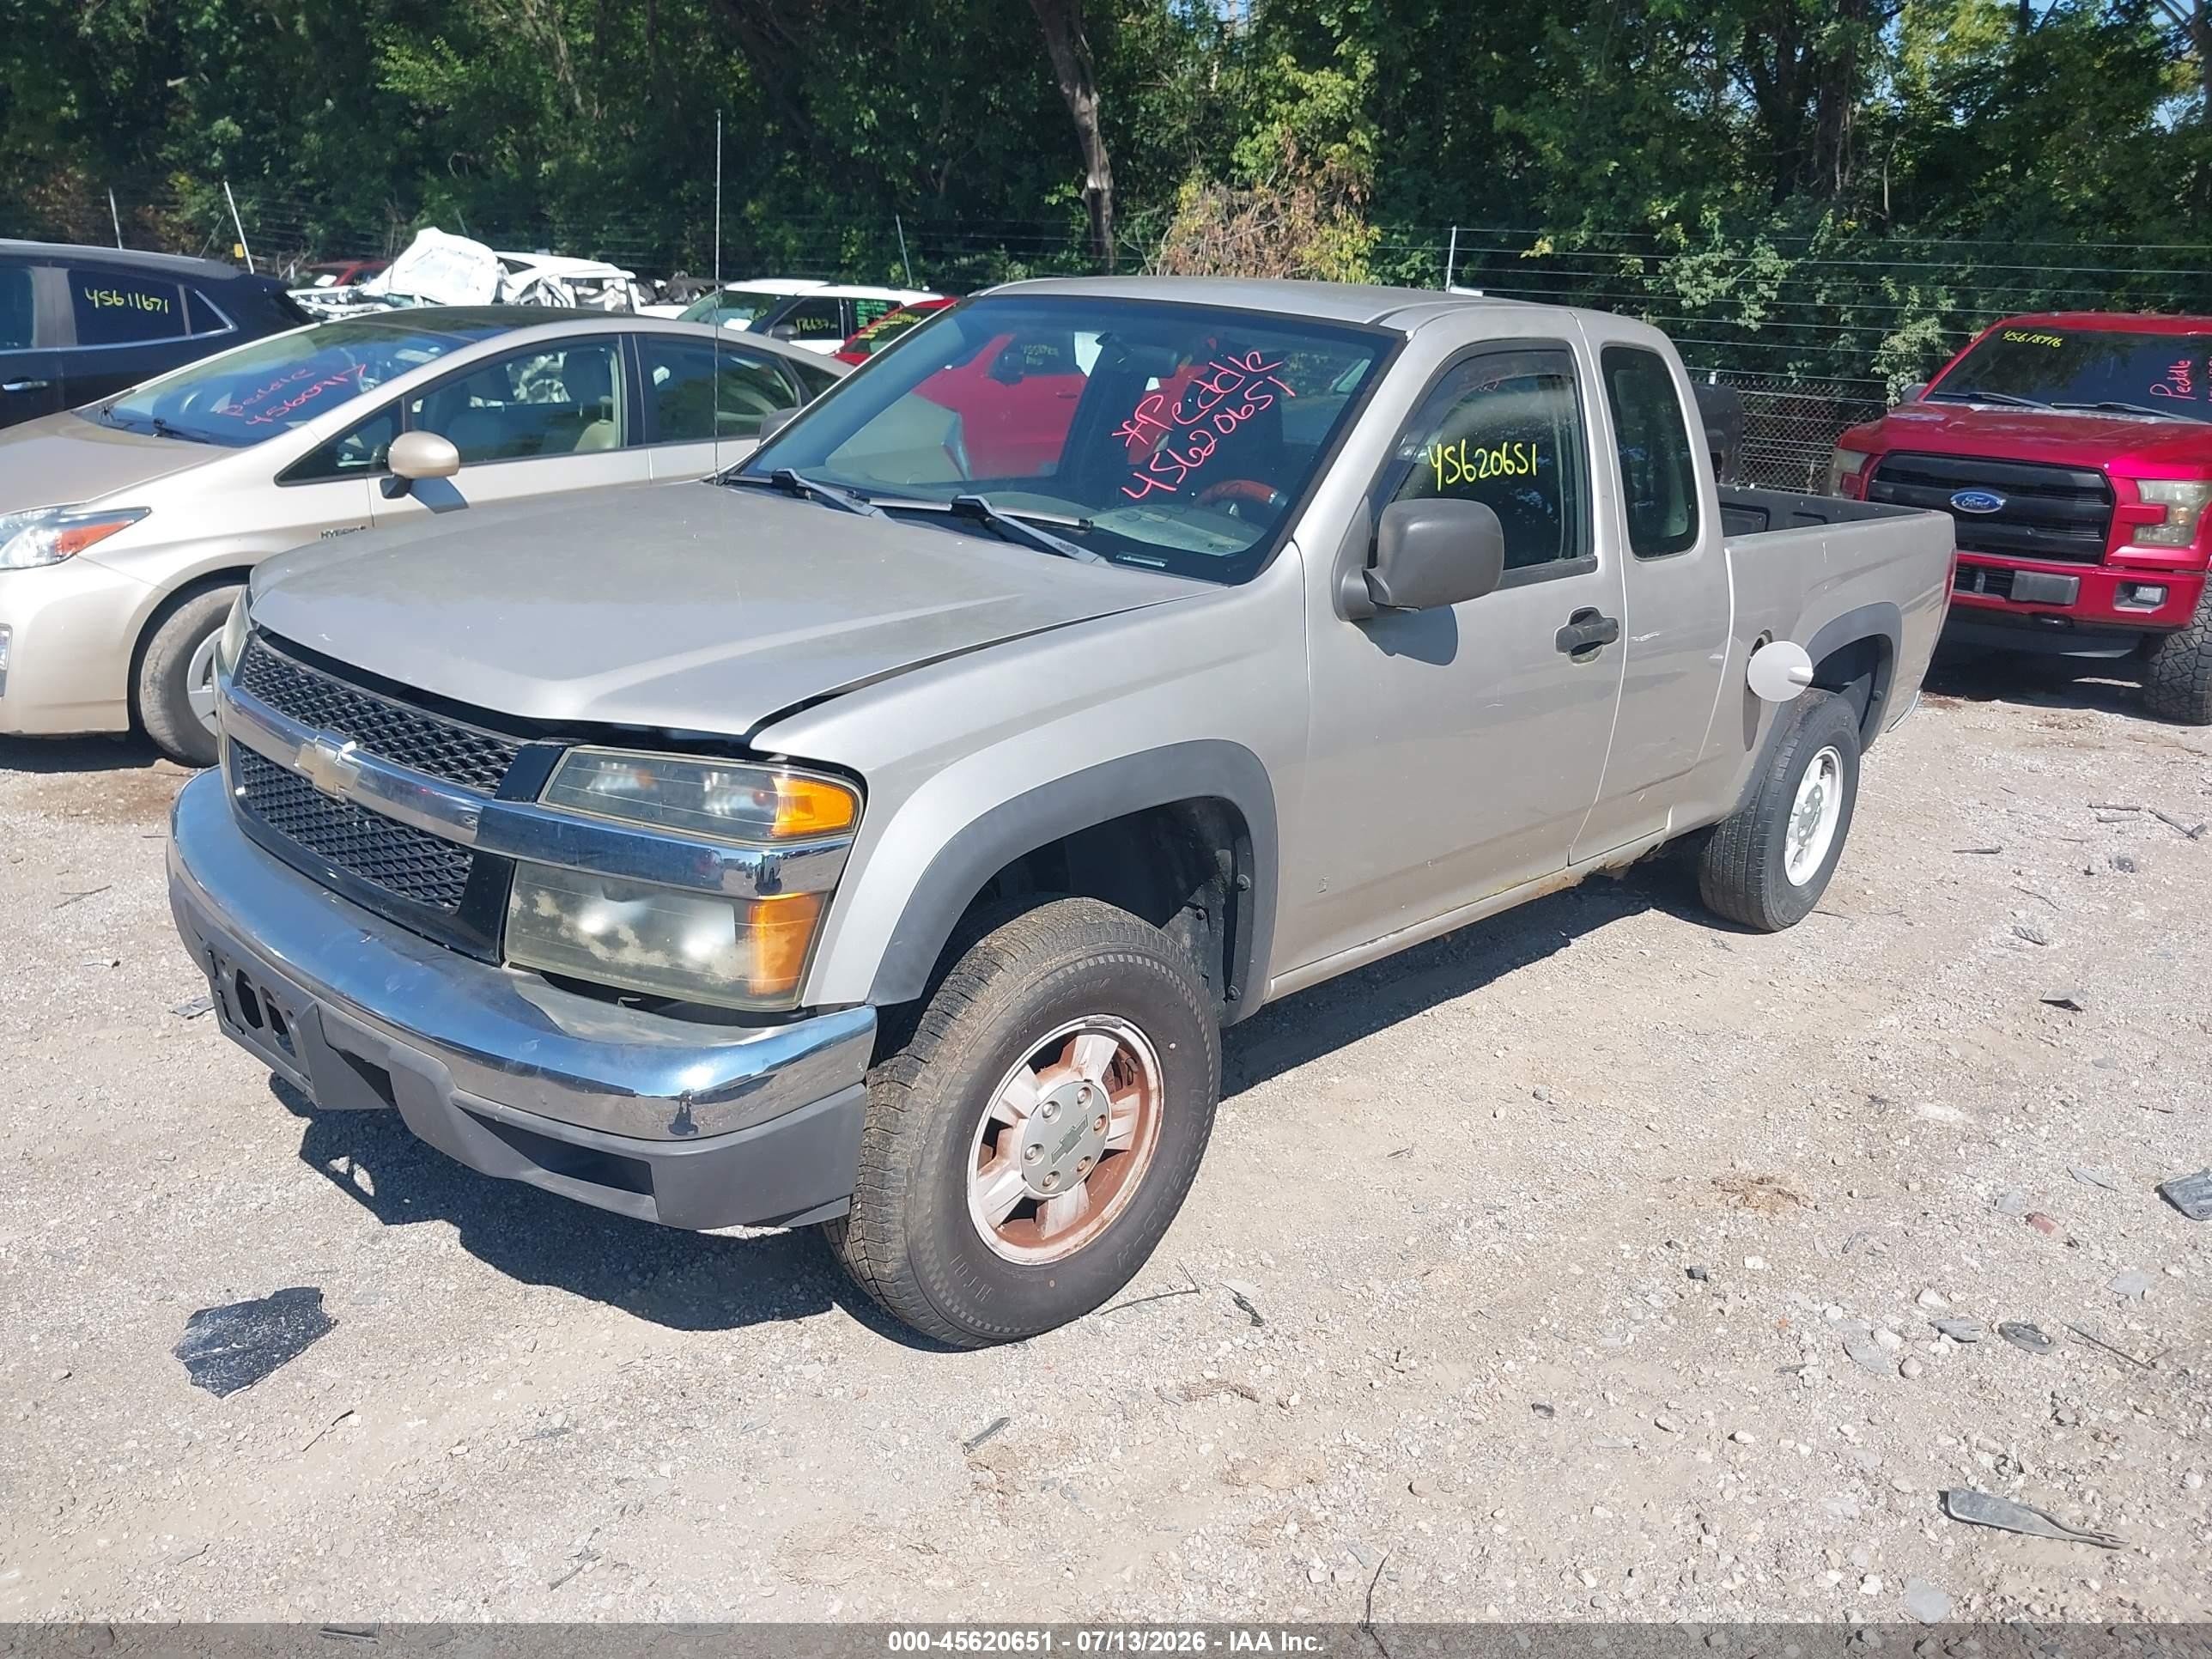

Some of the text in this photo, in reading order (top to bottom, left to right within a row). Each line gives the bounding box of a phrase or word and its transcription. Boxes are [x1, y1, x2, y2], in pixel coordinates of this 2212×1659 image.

[84, 286, 168, 314] 45611671
[1121, 375, 1296, 499] 45620651
[1427, 438, 1537, 492] 45620651
